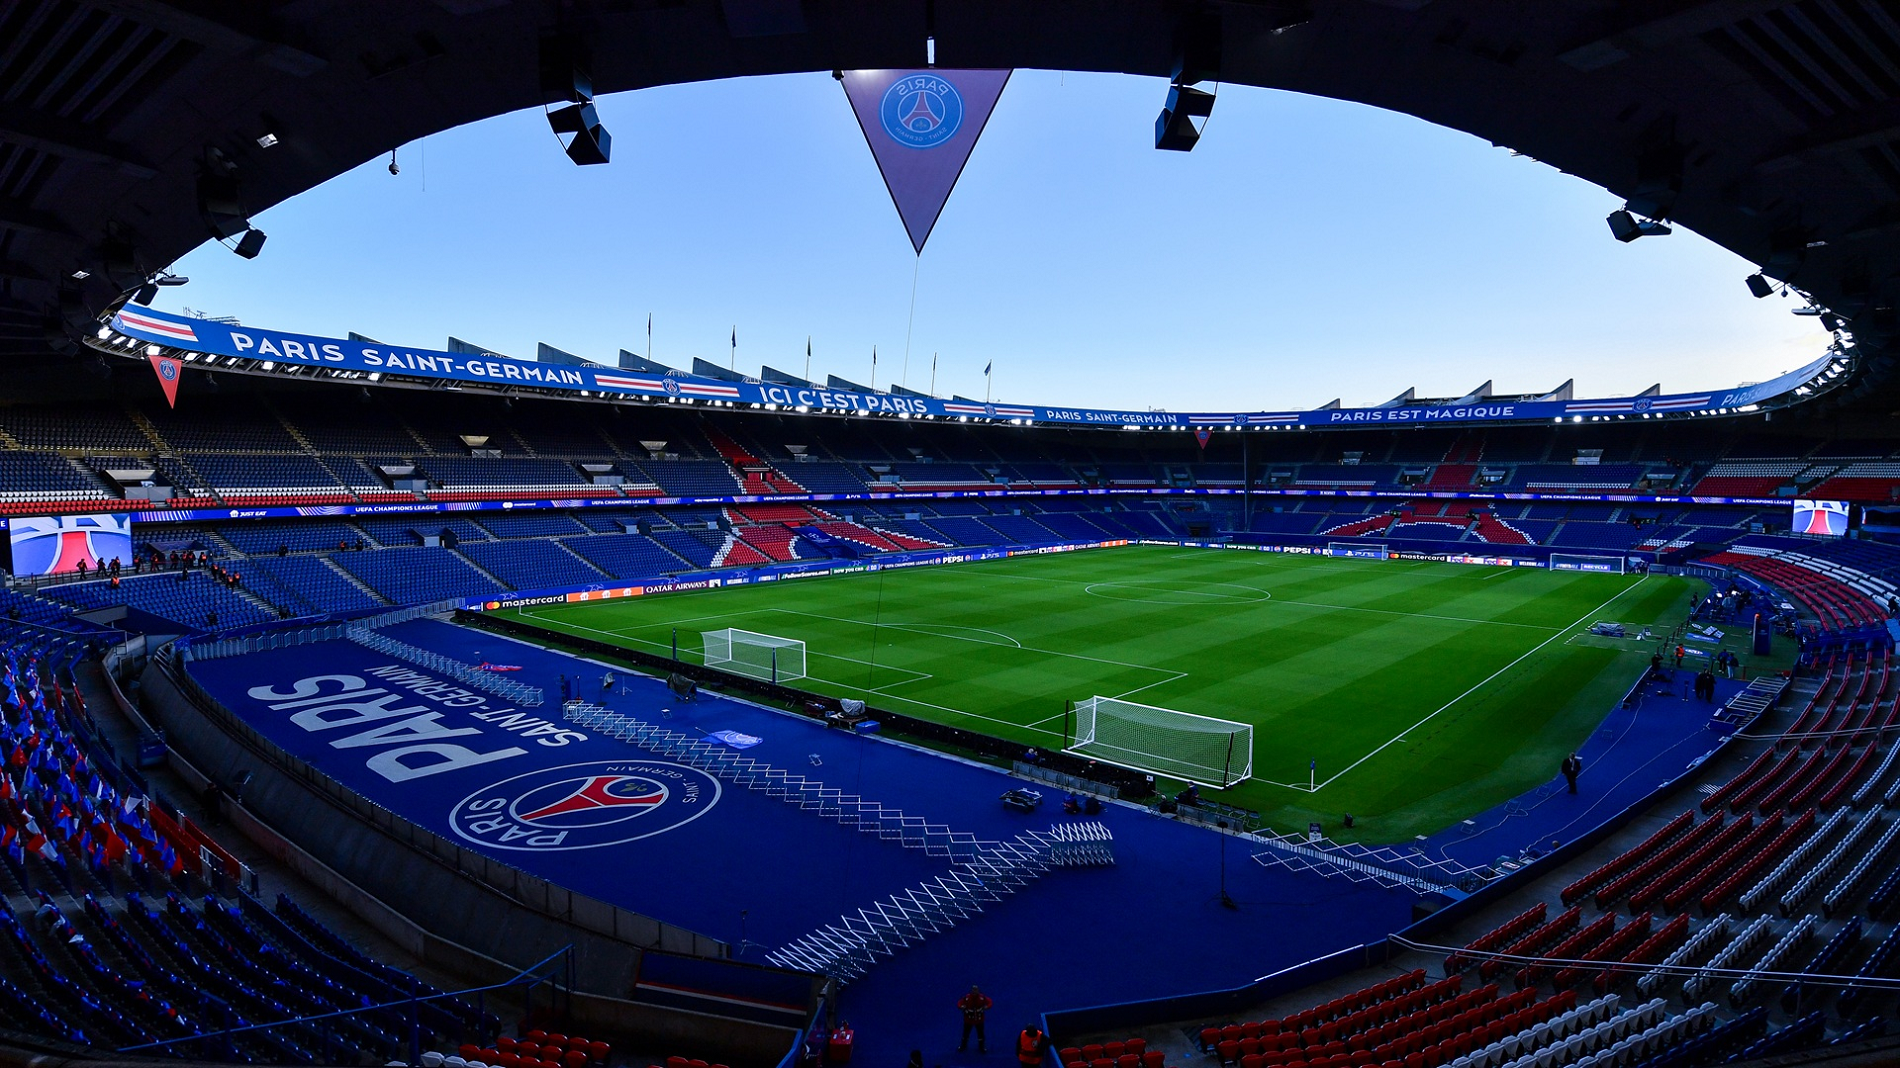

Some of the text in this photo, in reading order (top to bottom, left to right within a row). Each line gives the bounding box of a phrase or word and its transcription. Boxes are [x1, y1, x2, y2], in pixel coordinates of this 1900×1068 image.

[230, 331, 584, 386] PARIS SAINT-GERMAIN
[759, 386, 928, 413] ICI C'EST PARIS
[1046, 410, 1177, 423] PARIS SAINT-GERMAIN
[1331, 406, 1514, 422] PARIS EST MAGIQUE
[1283, 546, 1311, 554] PEPSI
[646, 581, 707, 593] QATAR AIRWAYS
[502, 595, 564, 607] mastercard
[364, 664, 588, 747] SAINT-GERMAIN
[247, 673, 529, 783] PARIS
[464, 797, 568, 846] PARIS
